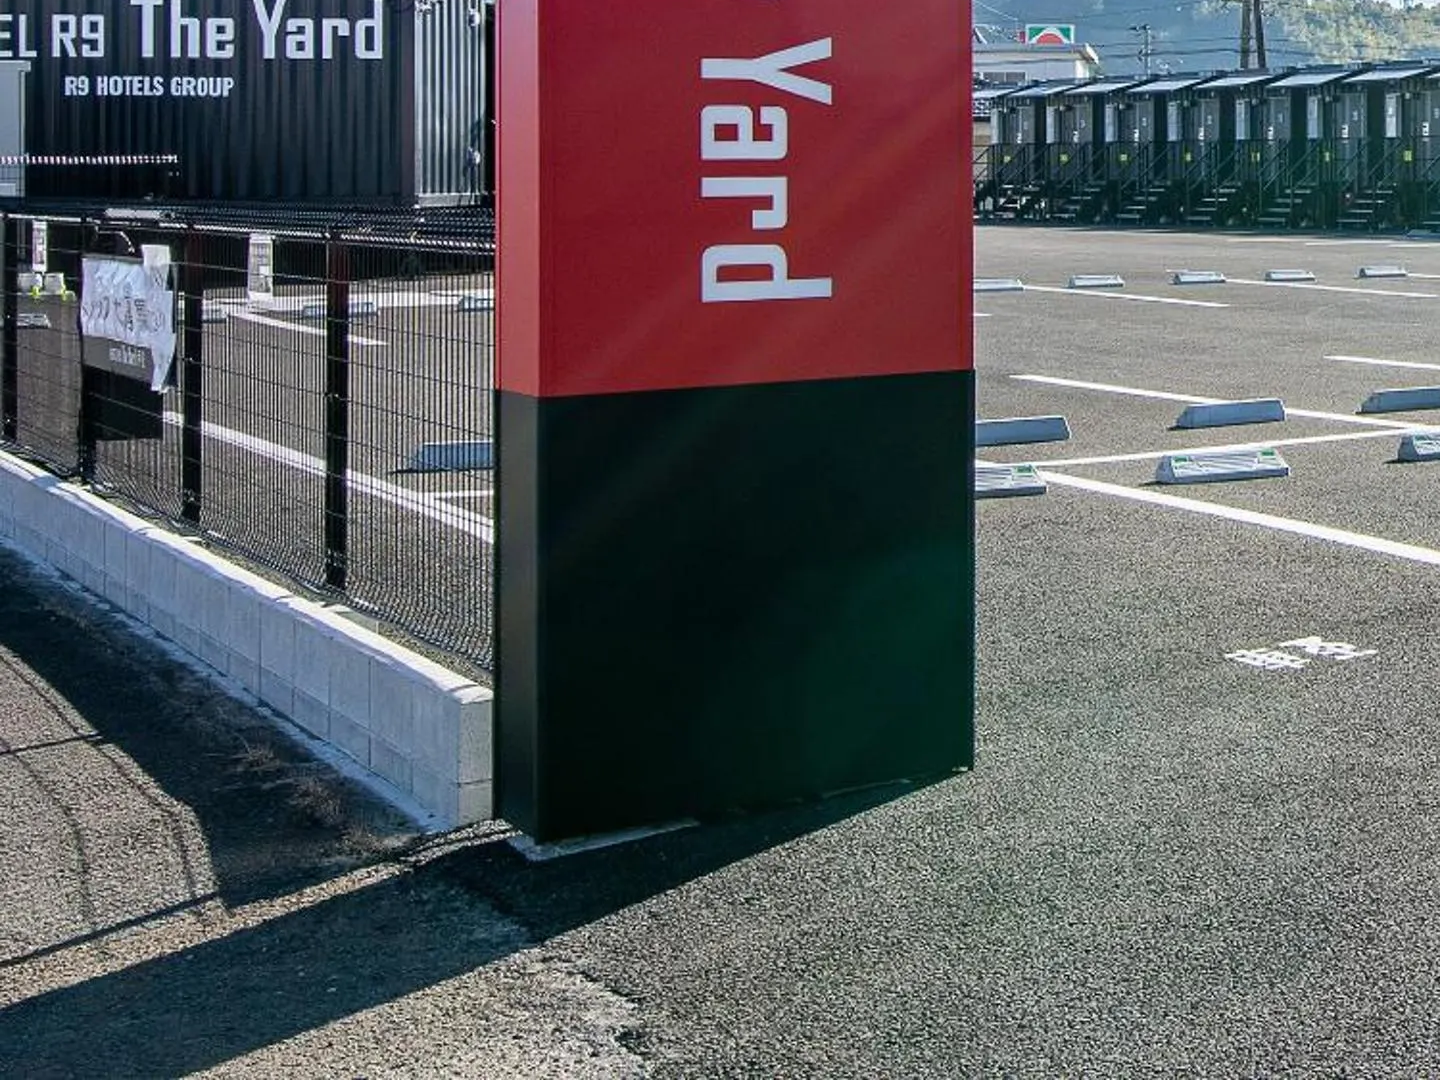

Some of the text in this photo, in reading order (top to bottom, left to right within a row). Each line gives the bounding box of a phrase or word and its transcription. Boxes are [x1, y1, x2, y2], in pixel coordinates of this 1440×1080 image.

[51, 14, 105, 58] R9
[65, 76, 234, 98] R9 HOTELS GROUP
[700, 37, 832, 303] Yard
